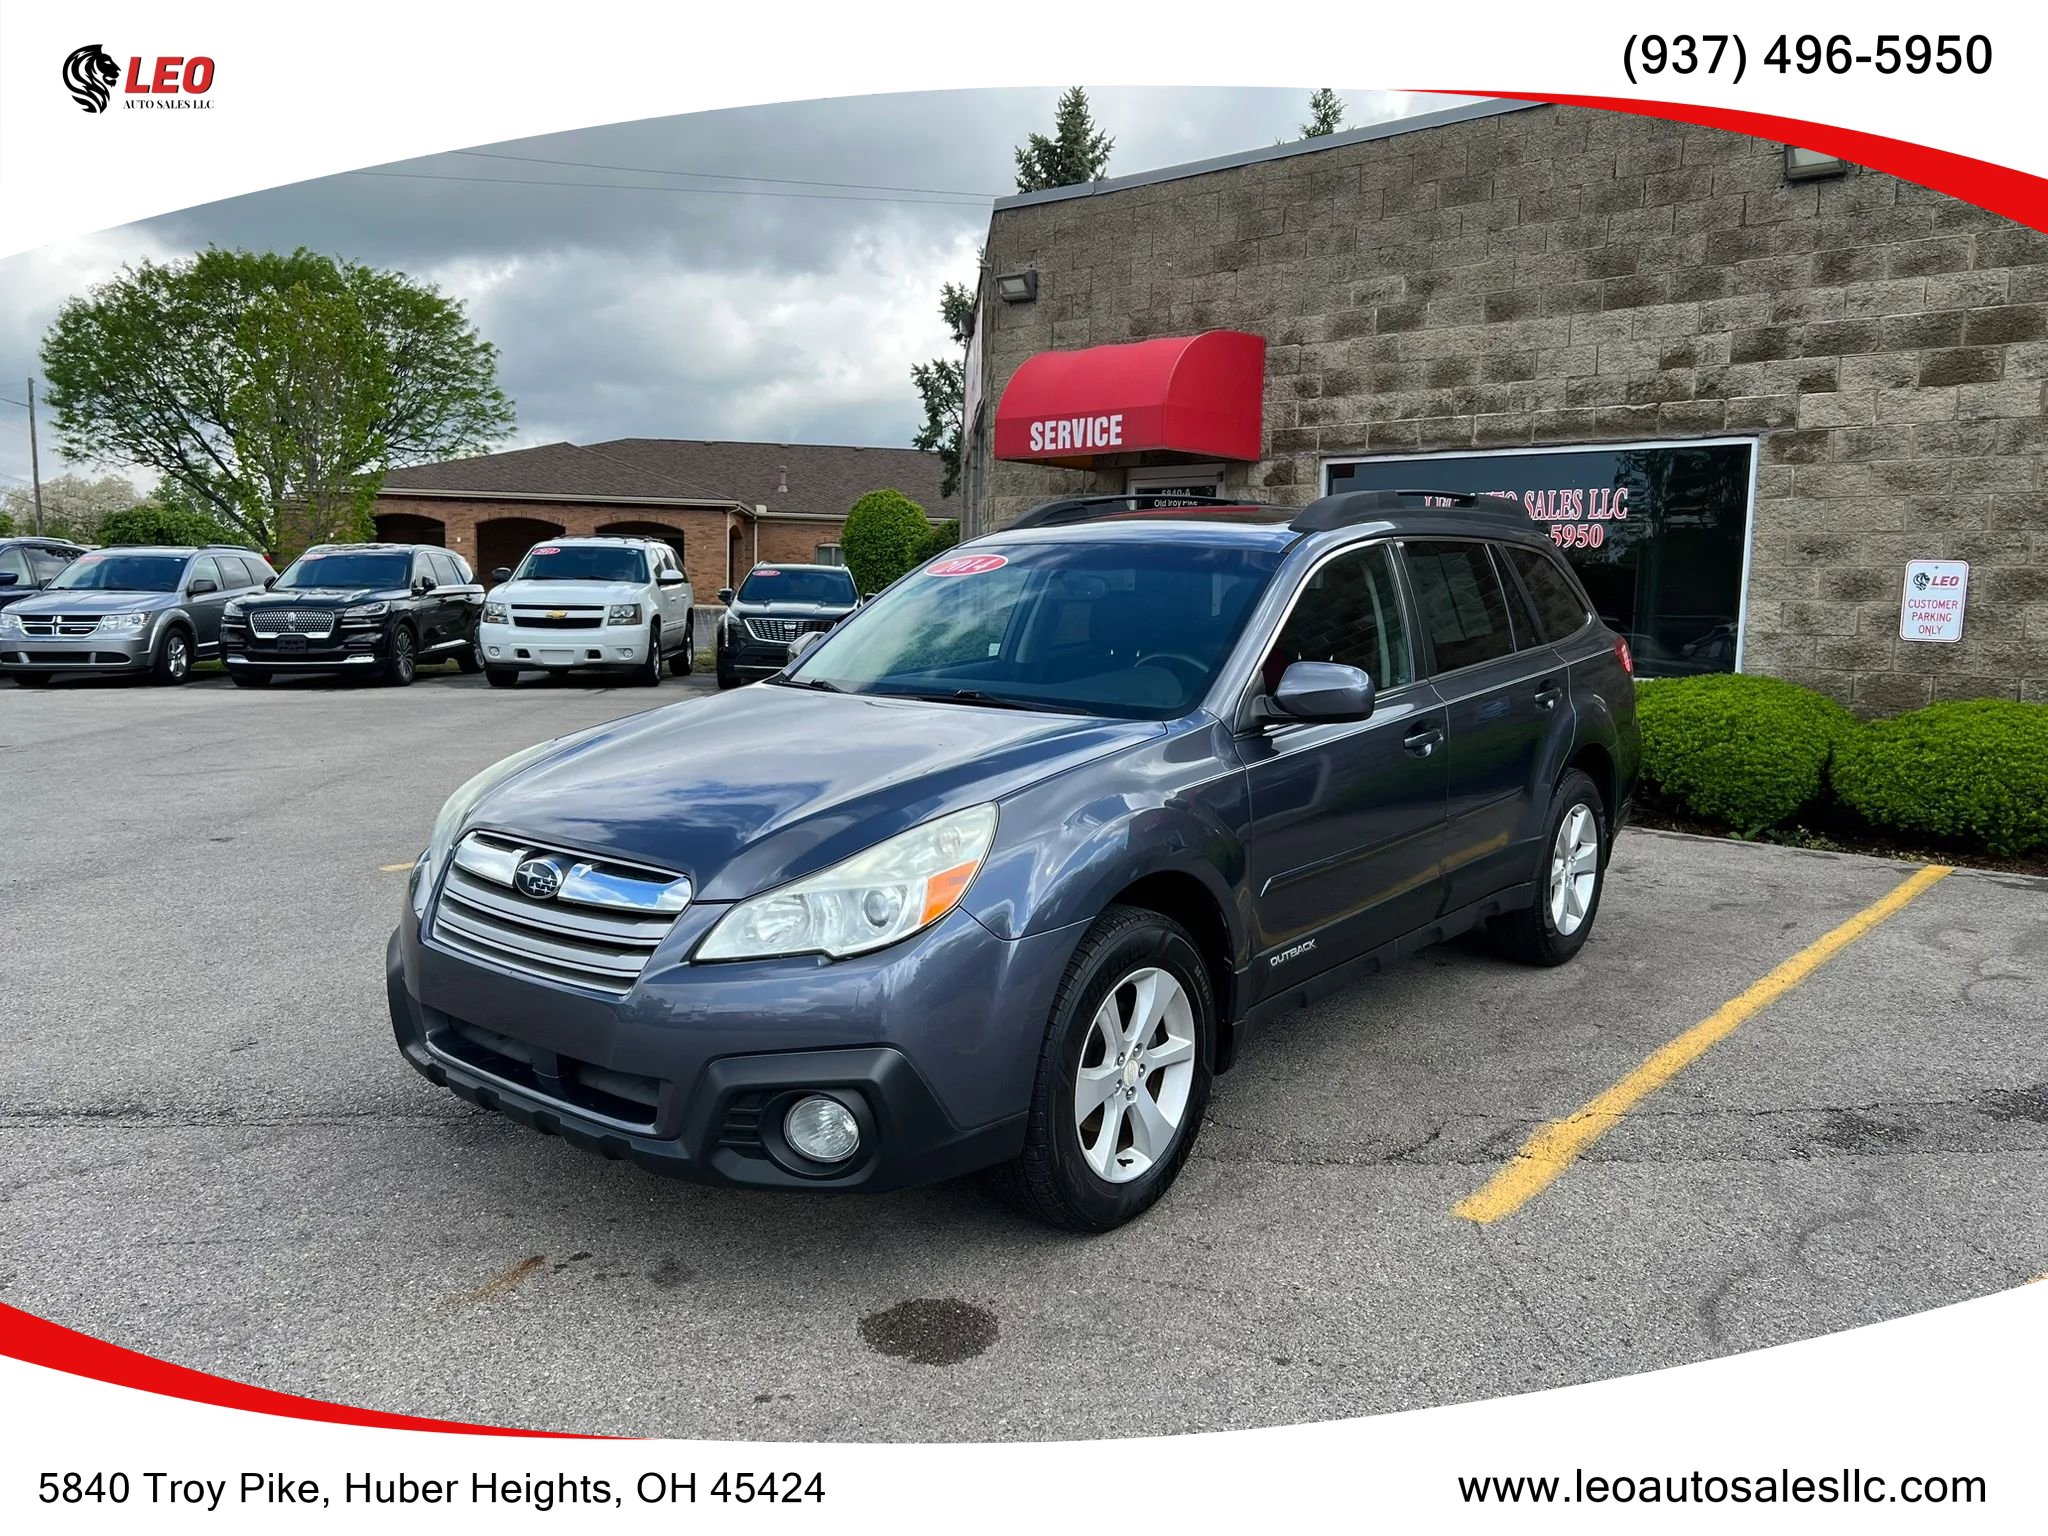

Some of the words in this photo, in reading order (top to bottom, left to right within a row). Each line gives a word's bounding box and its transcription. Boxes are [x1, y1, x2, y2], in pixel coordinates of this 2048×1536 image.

[1030, 414, 1123, 452] SERVICE
[1154, 499, 1167, 507] Old
[1524, 489, 1583, 520] SALES
[1588, 487, 1628, 519] LLC
[1931, 575, 1960, 587] LEO
[1908, 599, 1959, 610] CUSTOMER
[1911, 611, 1953, 623] PARKING
[1918, 624, 1943, 635] ONLY
[1270, 938, 1316, 967] OUTBACK
